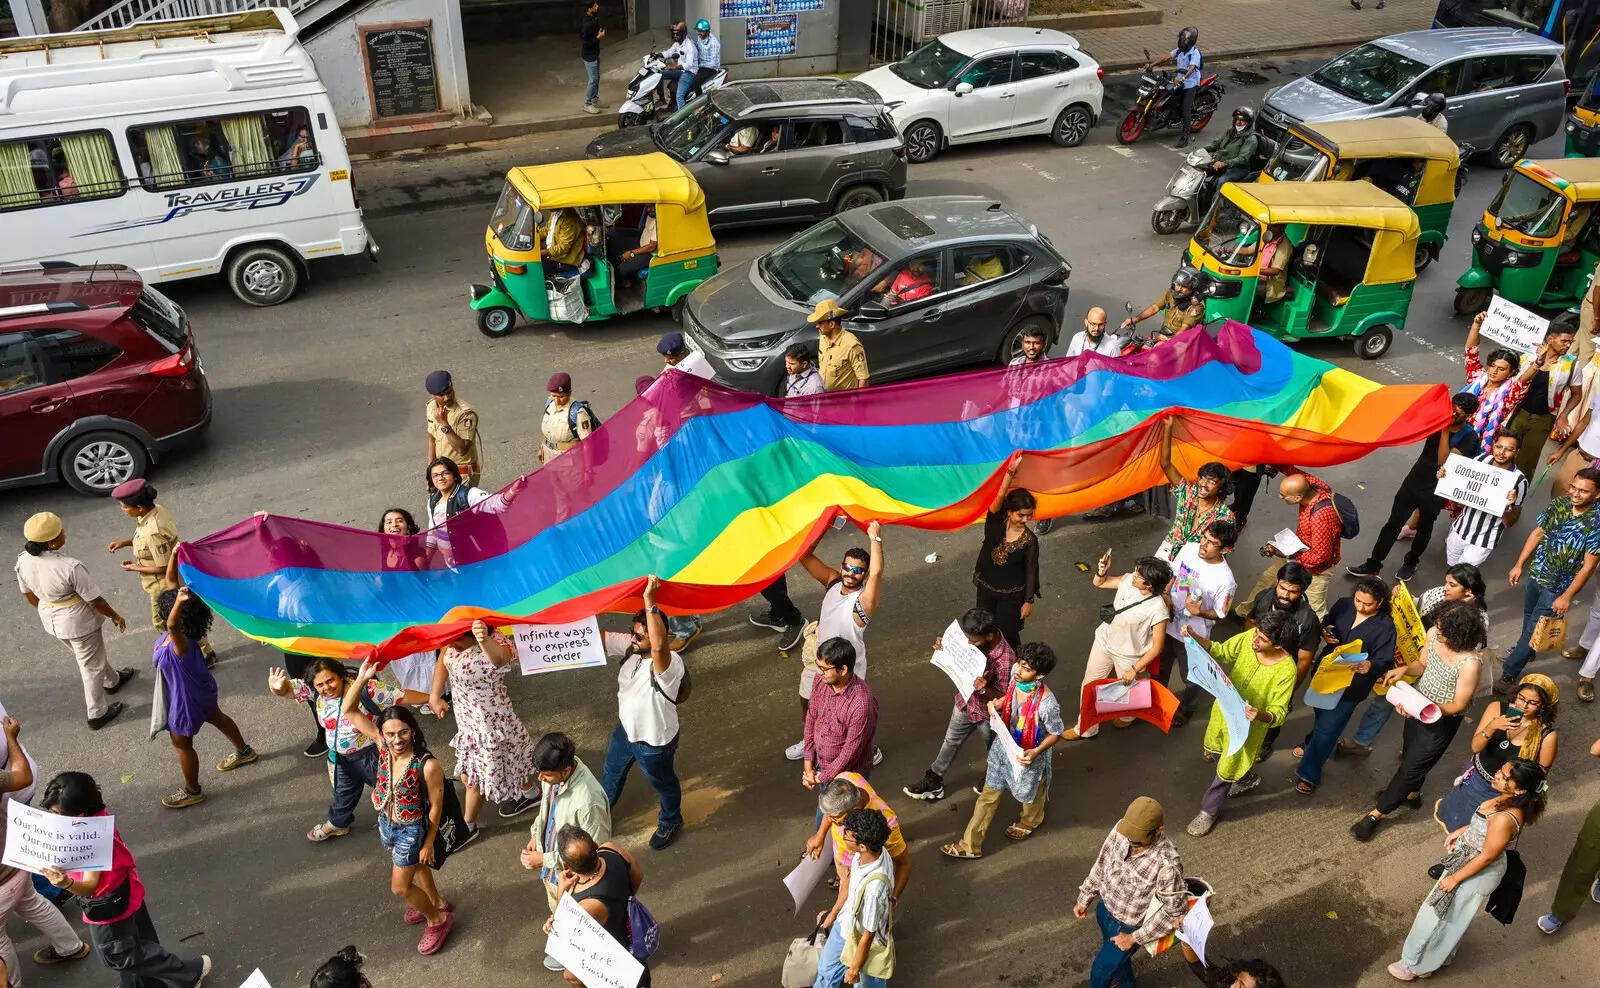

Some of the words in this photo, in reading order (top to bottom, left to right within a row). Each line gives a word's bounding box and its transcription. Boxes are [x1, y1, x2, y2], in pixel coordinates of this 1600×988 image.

[164, 181, 285, 207] TRAVELLER
[1454, 464, 1490, 484] Consent
[1466, 480, 1483, 493] NOT
[1452, 487, 1489, 508] Optional
[519, 629, 561, 642] Infinite
[563, 626, 593, 639] ways
[528, 644, 542, 653] to
[545, 638, 590, 652] express
[542, 652, 582, 663] Gender
[13, 816, 33, 830] Our
[34, 823, 54, 839] love
[56, 830, 65, 840] is
[68, 831, 101, 841] valid.
[22, 832, 40, 846] Our
[42, 841, 93, 853] marriage
[20, 844, 50, 862] should
[53, 854, 67, 864] be
[71, 852, 94, 862] too!
